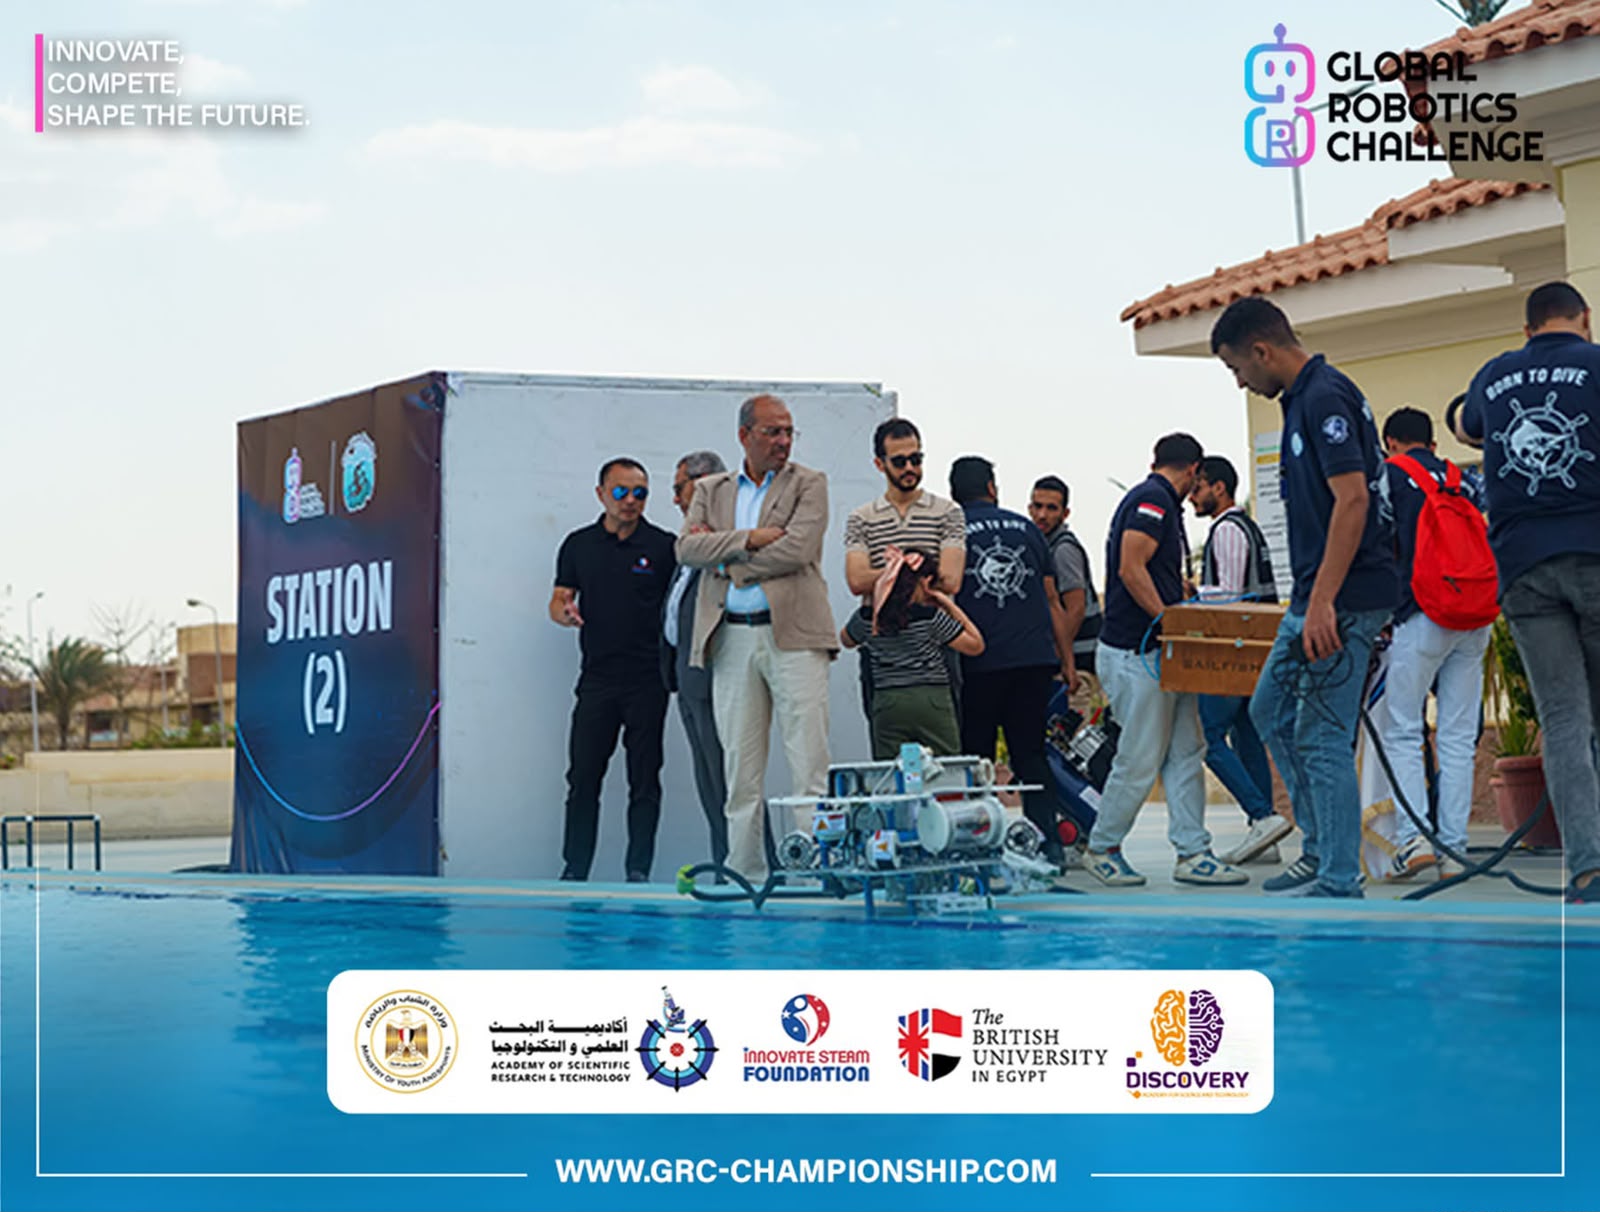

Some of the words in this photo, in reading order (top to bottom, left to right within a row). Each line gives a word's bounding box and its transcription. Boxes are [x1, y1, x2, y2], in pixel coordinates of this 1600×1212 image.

[1485, 371, 1523, 401] BORN
[1528, 368, 1548, 384] TO
[1551, 367, 1589, 386] DIVE
[267, 560, 392, 644] STATION
[303, 650, 347, 735] (2)
